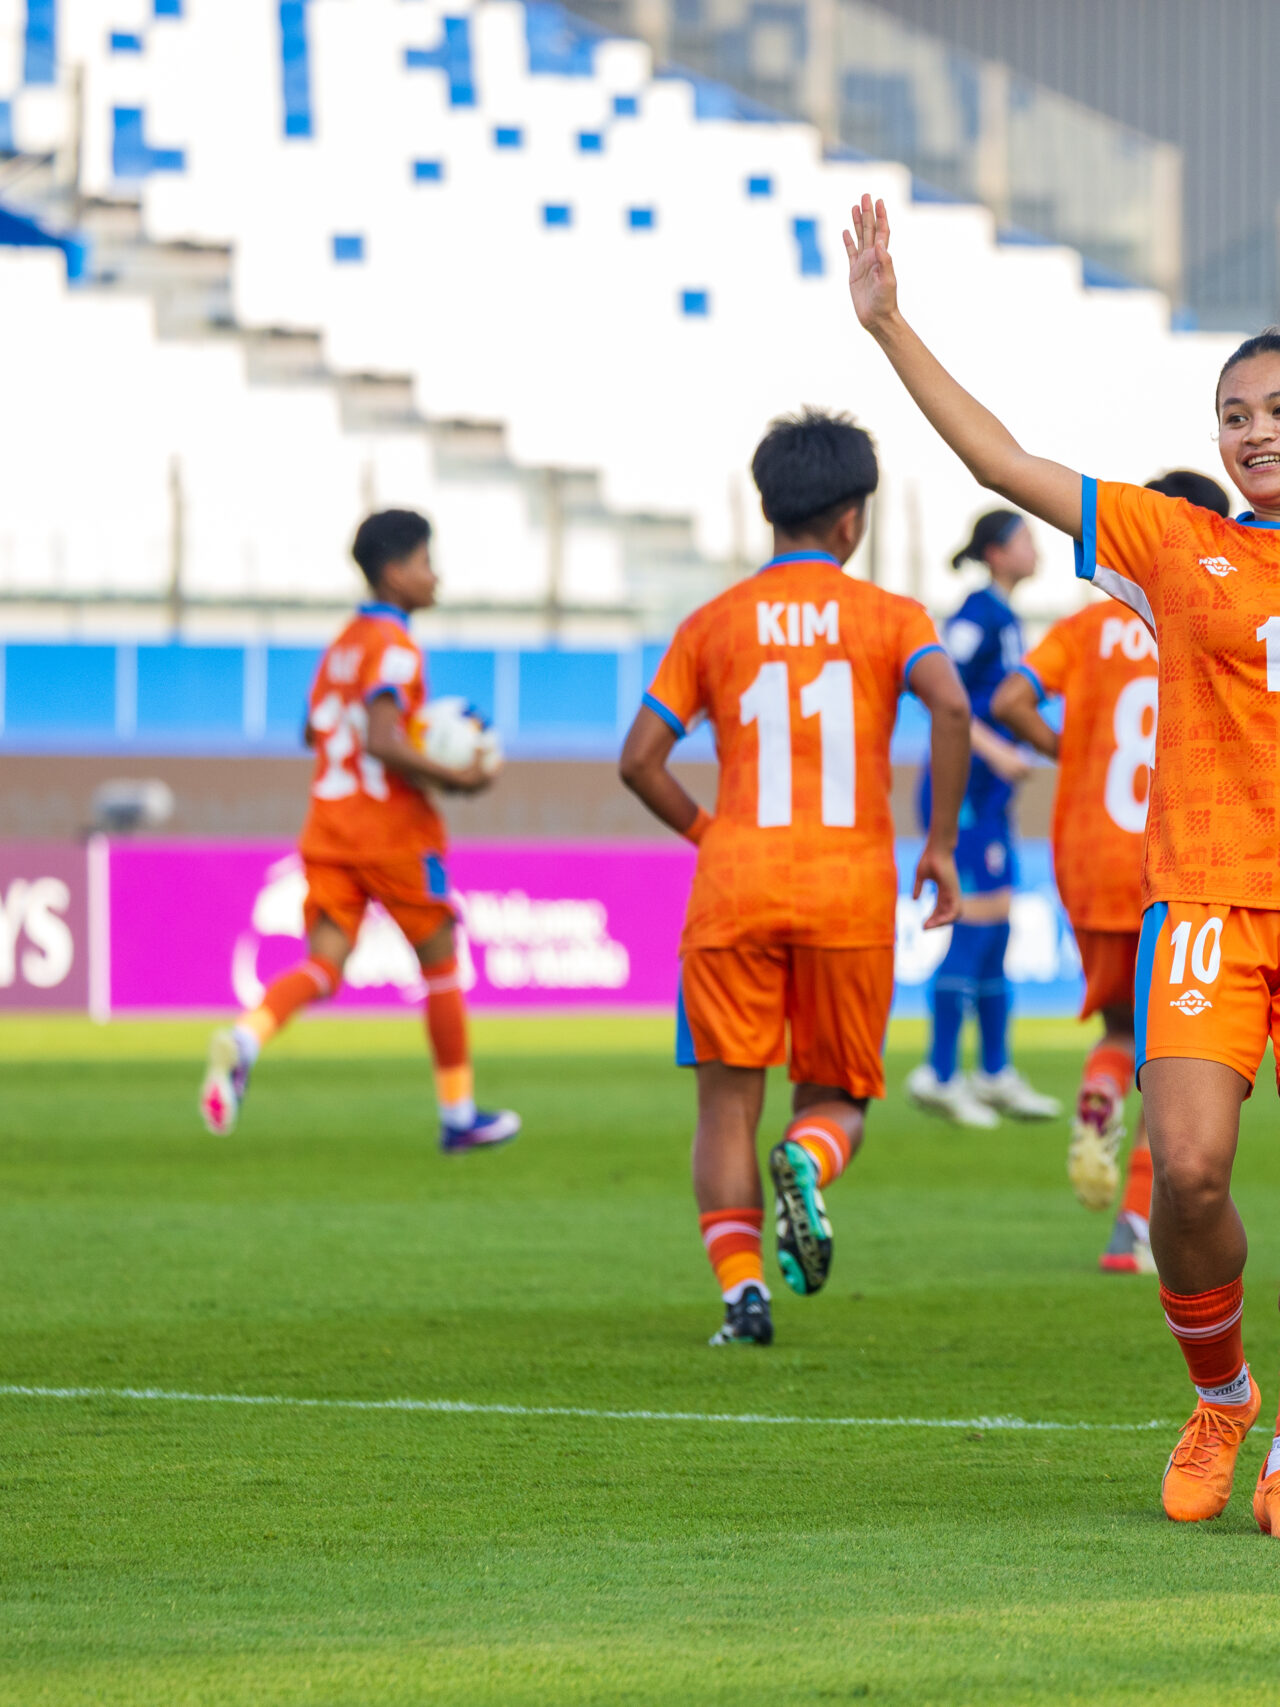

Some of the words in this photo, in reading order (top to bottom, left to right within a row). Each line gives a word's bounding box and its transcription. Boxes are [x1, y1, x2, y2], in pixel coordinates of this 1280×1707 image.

[756, 600, 840, 646] KIM
[739, 660, 856, 828] 11
[1103, 674, 1159, 834] 8
[1169, 917, 1224, 985] 10
